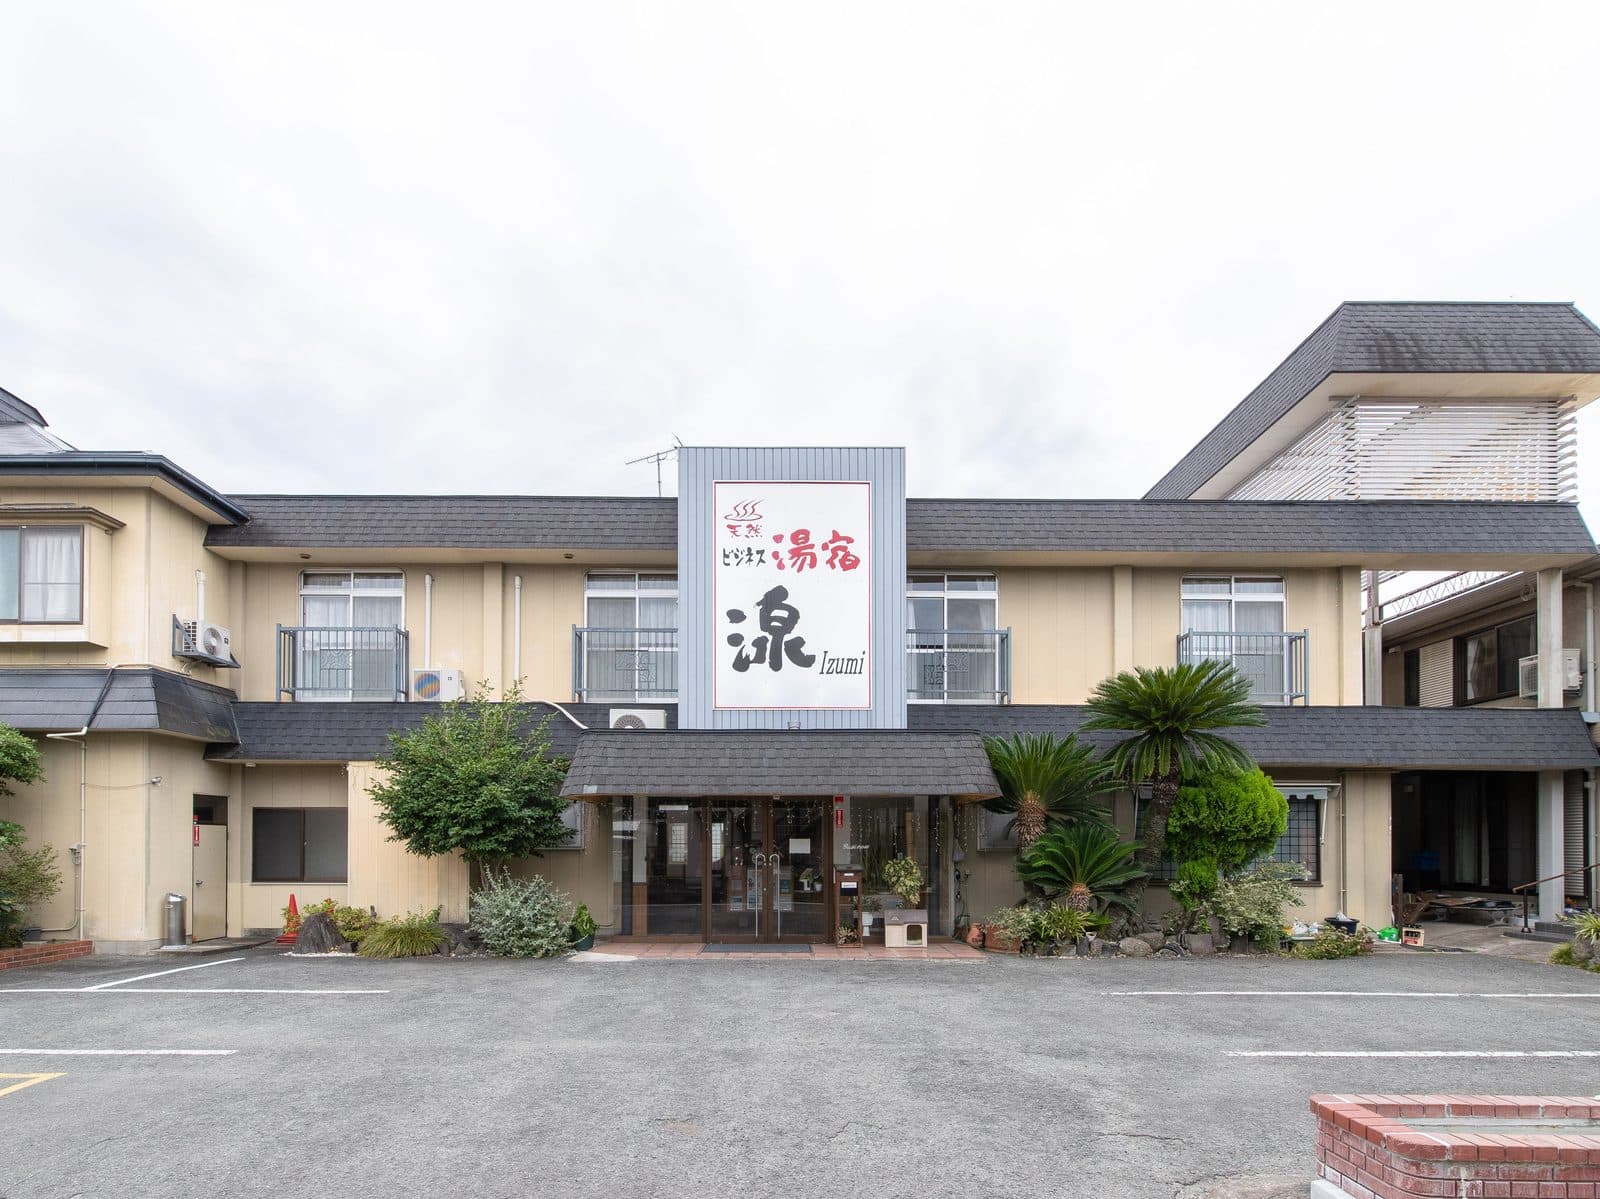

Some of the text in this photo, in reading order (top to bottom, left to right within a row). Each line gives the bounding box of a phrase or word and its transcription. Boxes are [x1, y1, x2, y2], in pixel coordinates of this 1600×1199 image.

[726, 523, 763, 539] 天然
[722, 528, 861, 574] ビジネス 湯宿
[819, 650, 866, 675] Izumi
